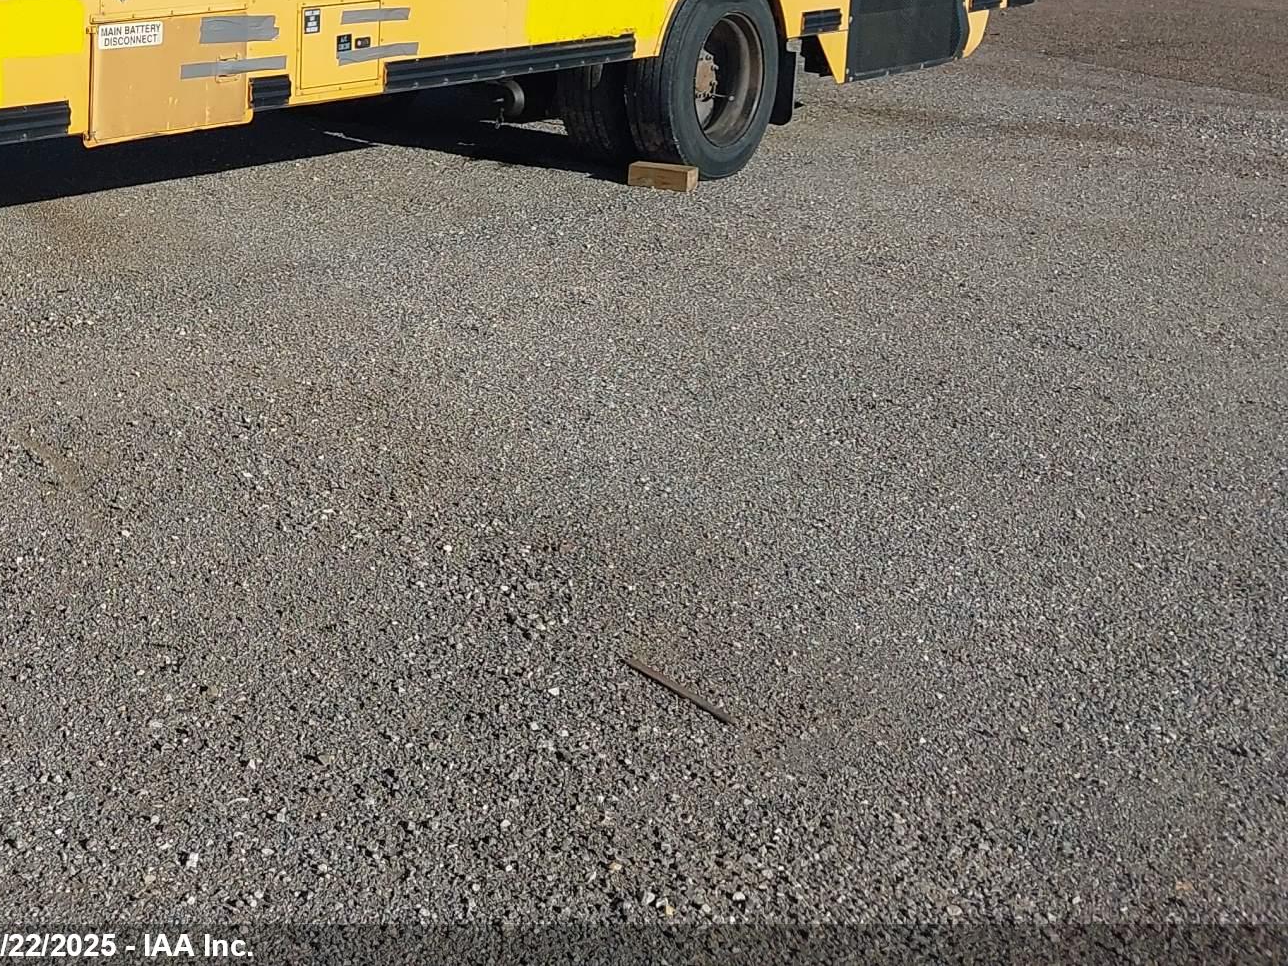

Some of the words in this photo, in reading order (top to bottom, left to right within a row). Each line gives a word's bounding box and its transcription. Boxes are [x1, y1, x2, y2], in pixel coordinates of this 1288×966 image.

[101, 26, 122, 37] MAIN
[124, 24, 161, 35] BATTERY
[104, 34, 158, 47] DISCONNECT
